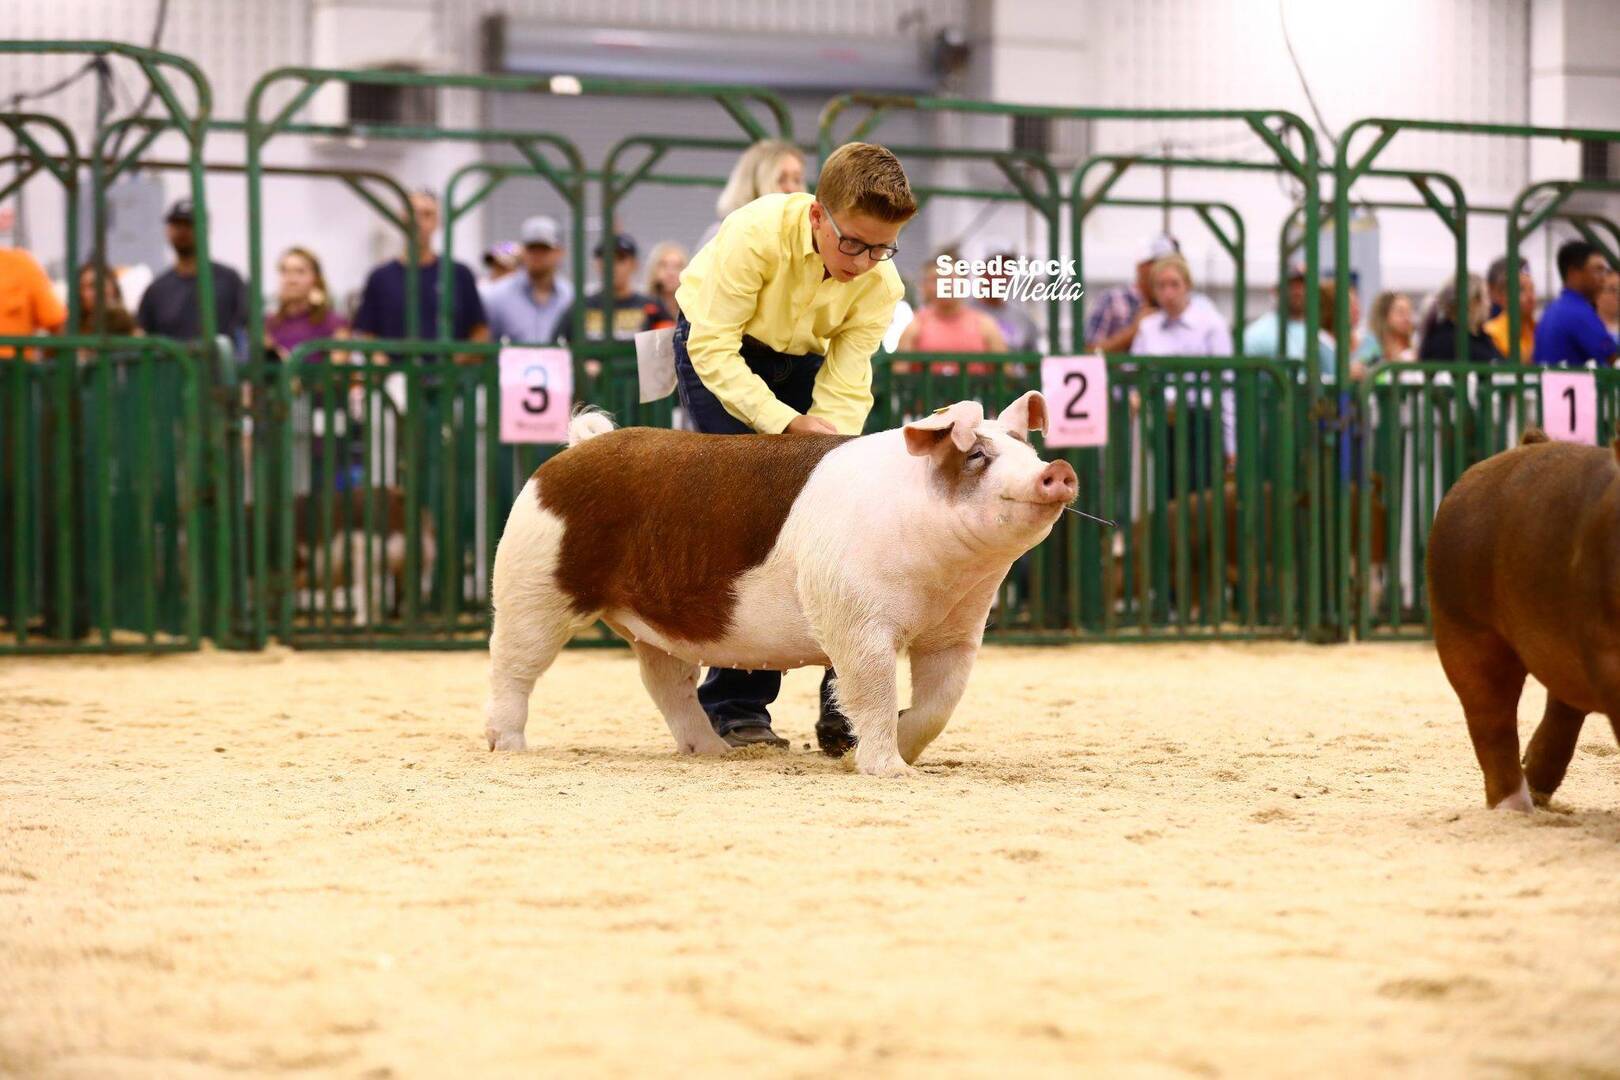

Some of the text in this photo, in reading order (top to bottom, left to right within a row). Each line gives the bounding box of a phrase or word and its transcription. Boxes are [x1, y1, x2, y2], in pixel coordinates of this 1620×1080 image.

[522, 364, 550, 416] 3
[1062, 371, 1089, 420] 2
[1562, 386, 1577, 433] 1
